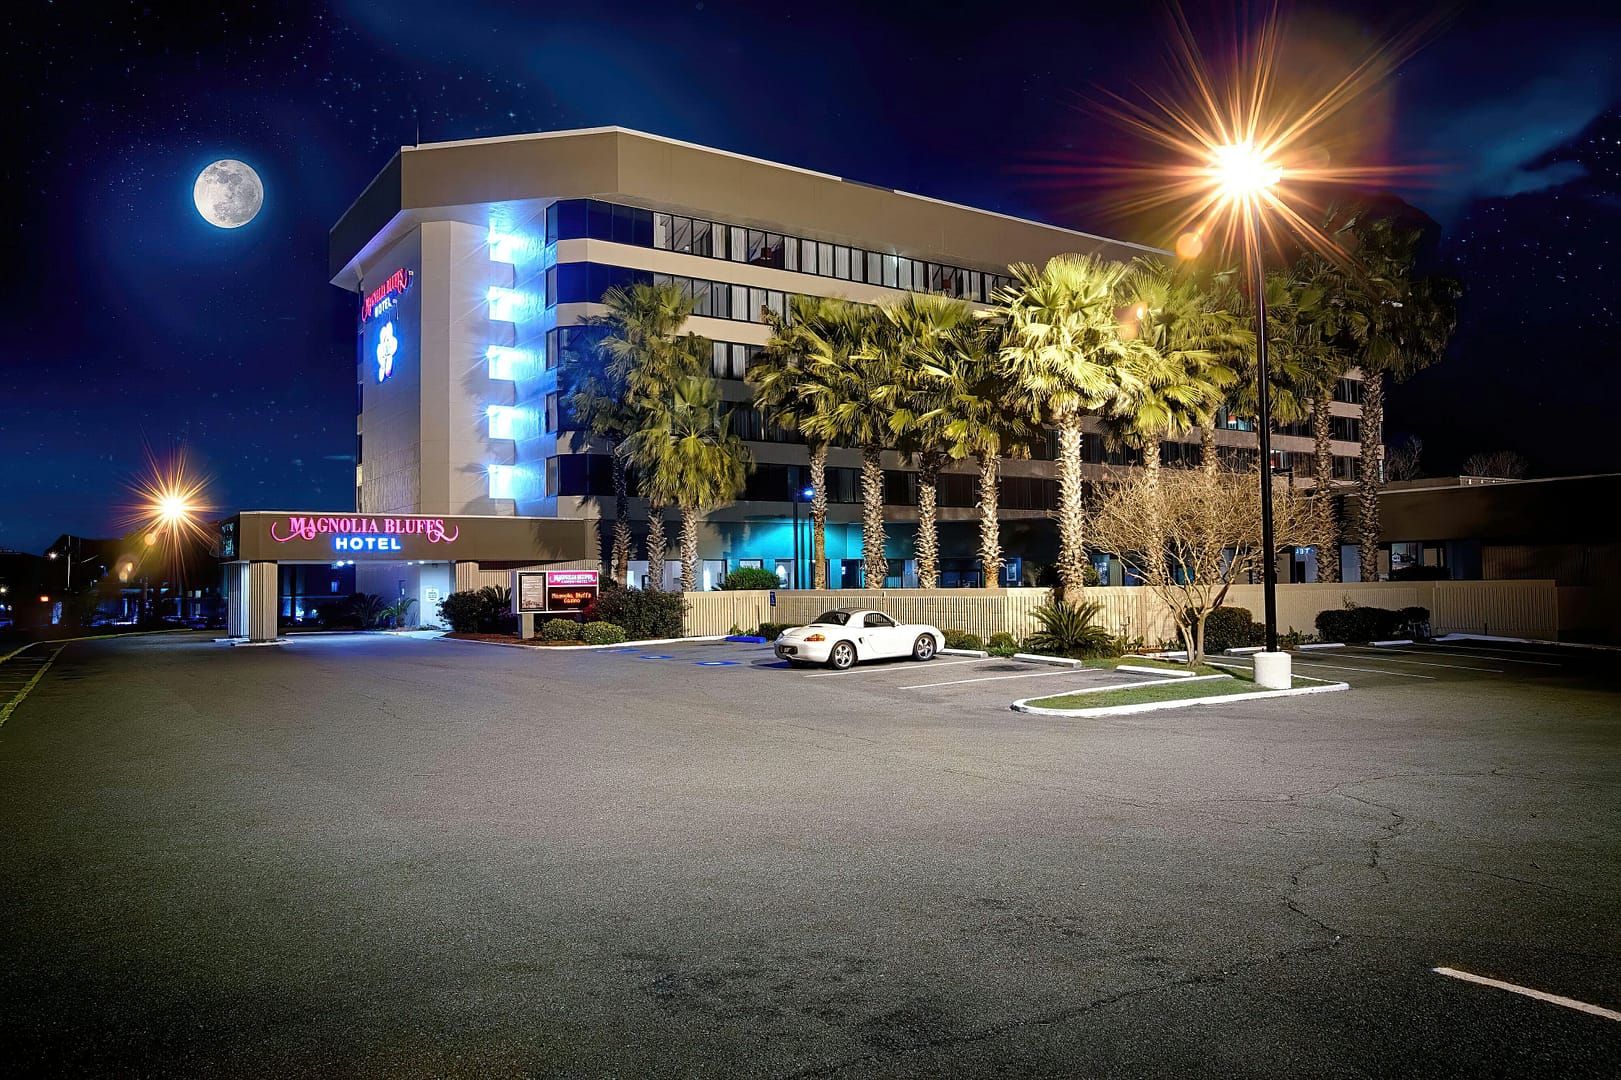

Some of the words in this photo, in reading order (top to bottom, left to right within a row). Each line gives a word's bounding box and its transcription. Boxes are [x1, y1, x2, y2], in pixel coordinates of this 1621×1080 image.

[271, 517, 379, 541] MAGNOLIA
[384, 518, 459, 543] BLUFFS
[335, 537, 401, 550] HOTEL
